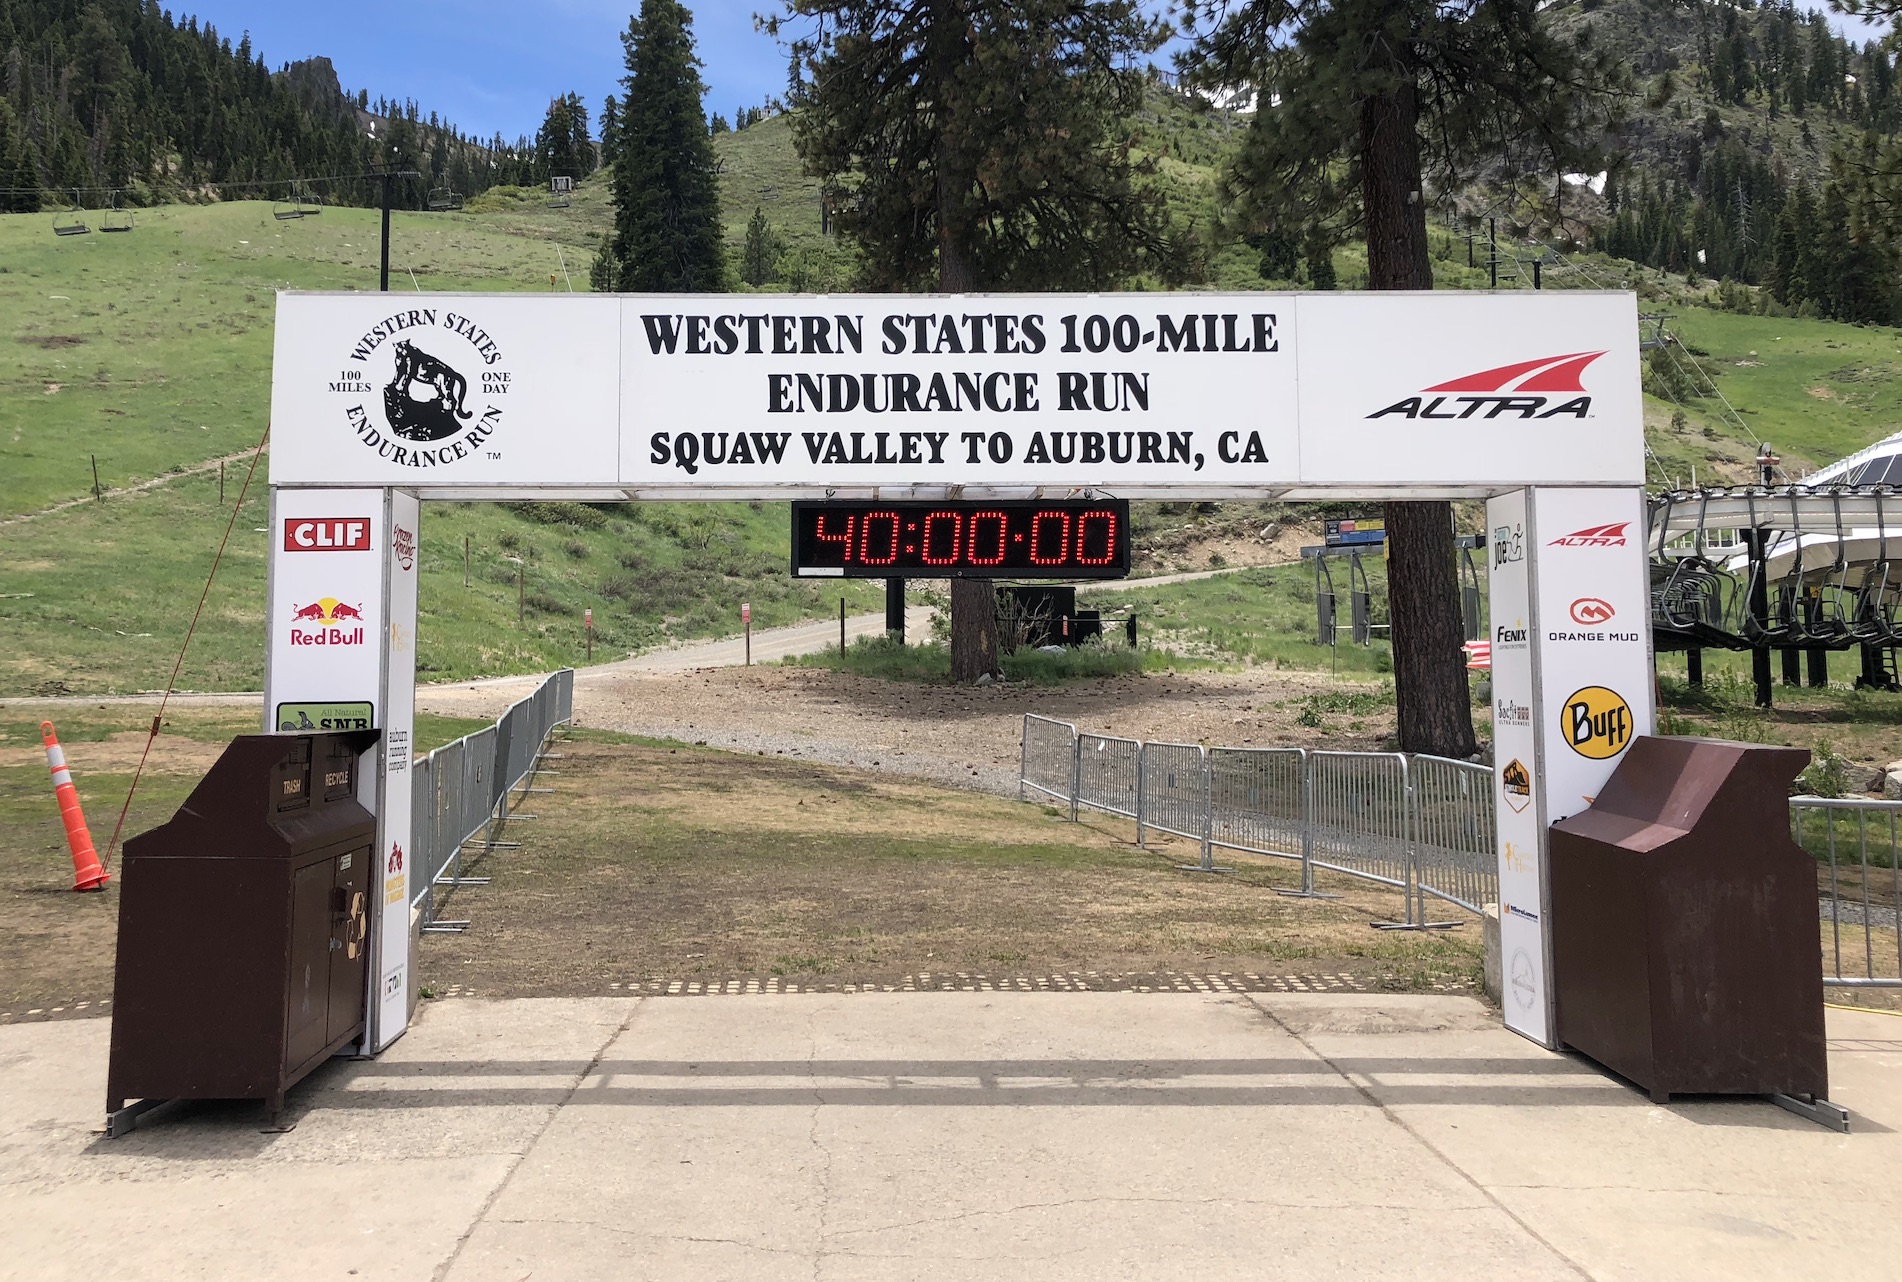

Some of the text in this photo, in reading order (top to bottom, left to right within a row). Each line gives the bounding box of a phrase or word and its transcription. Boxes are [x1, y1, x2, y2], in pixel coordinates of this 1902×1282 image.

[350, 309, 502, 366] WESTERN STATES
[640, 313, 1279, 355] WESTERN STATES 100-MILE
[340, 370, 362, 381] 100
[481, 371, 512, 383] ONE
[329, 382, 372, 393] MILES
[482, 383, 510, 395] DAY
[768, 371, 1150, 414] ENDURANCE RUN
[1364, 396, 1592, 419] ALTRA
[345, 403, 503, 468] ENDURANCE RUN
[650, 430, 1269, 475] SQUAW VALLEY TO AUBURN, CA
[294, 522, 363, 547] CLIF
[1546, 537, 1627, 547] ALTRA
[290, 628, 364, 646] Red Bull
[1549, 632, 1639, 642] ORANGE MUD
[320, 708, 367, 717] All Natural
[389, 727, 408, 742] auburn
[388, 744, 408, 760] running
[388, 760, 407, 774] company
[325, 770, 349, 787] RECYCLE
[283, 779, 301, 795] TRASH
